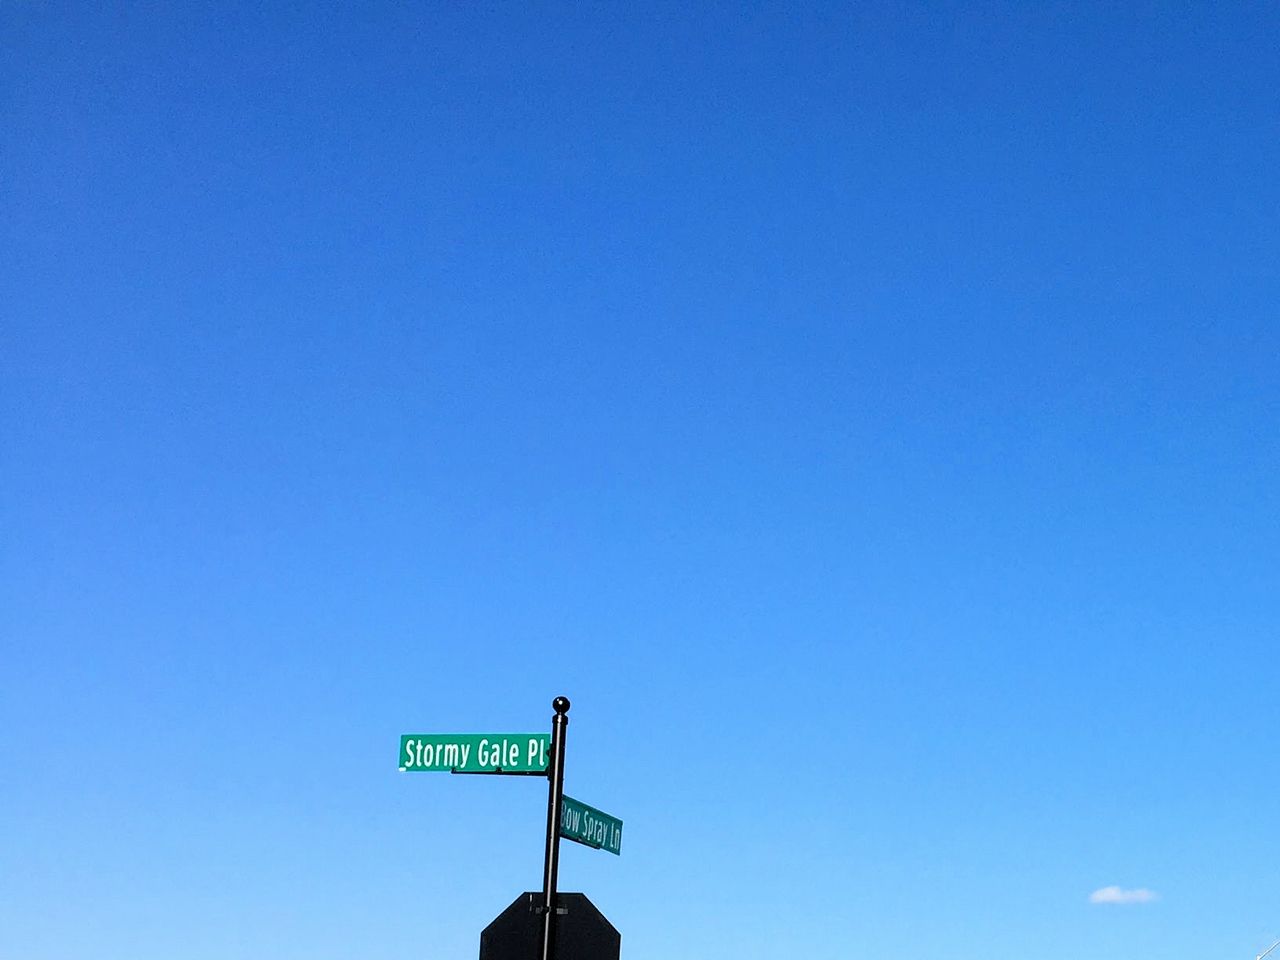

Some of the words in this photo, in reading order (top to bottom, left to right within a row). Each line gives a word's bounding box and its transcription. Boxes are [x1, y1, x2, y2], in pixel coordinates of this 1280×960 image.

[405, 740, 470, 768] Stormy
[478, 739, 519, 767] Gale
[527, 739, 545, 767] Pl
[583, 810, 608, 847] Spray
[610, 822, 621, 850] Ln
